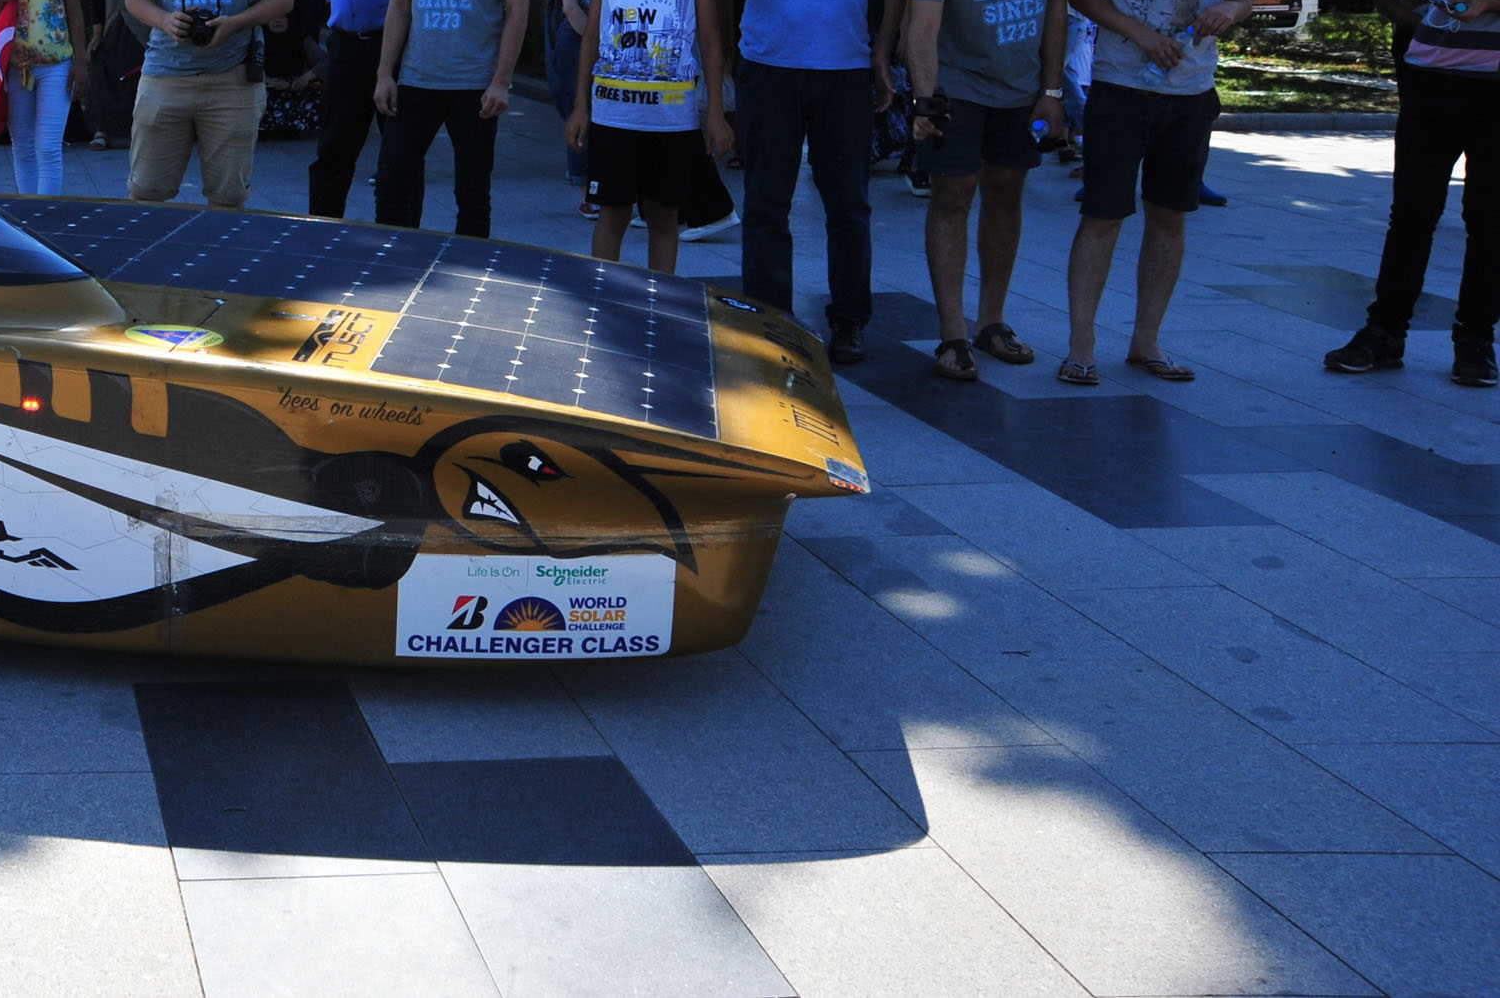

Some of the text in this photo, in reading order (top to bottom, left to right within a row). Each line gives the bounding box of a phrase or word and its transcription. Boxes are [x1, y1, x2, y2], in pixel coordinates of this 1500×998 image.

[422, 11, 461, 29] 1773
[996, 18, 1038, 46] 1773
[595, 85, 620, 101] FREE
[622, 89, 659, 105] STYLE
[330, 401, 355, 418] on
[467, 566, 488, 577] Life
[490, 566, 500, 577] Is
[536, 565, 609, 578] Schneider
[566, 577, 607, 585] Electric
[569, 596, 627, 610] WORLD
[569, 609, 626, 622] SOLAR
[569, 622, 626, 632] CHALLENGE
[407, 634, 660, 654] CHALLENGER CLASS
